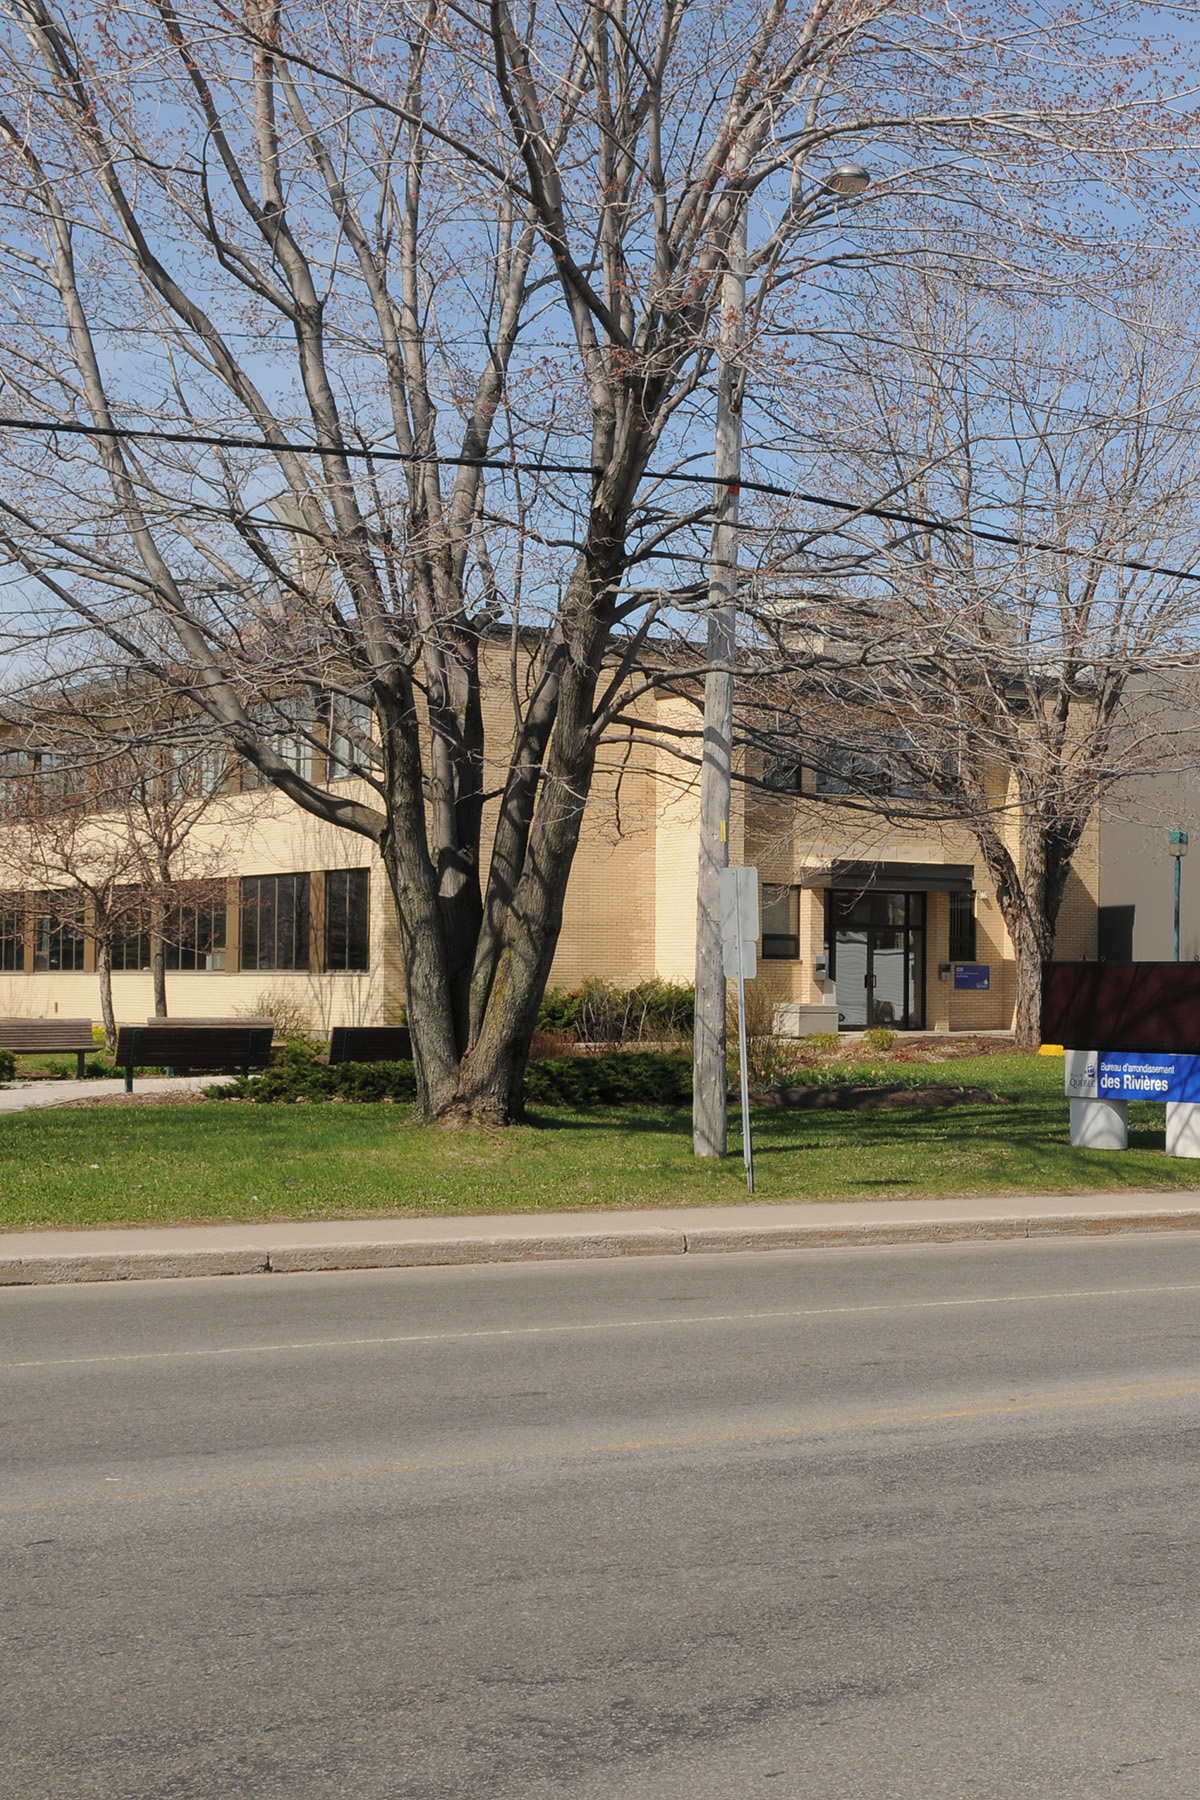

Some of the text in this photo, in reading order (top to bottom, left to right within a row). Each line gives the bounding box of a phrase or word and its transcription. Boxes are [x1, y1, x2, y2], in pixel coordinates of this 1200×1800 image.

[1100, 1062, 1175, 1075] Bureau d'arrondissement
[1100, 1073, 1169, 1092] des Rivières
